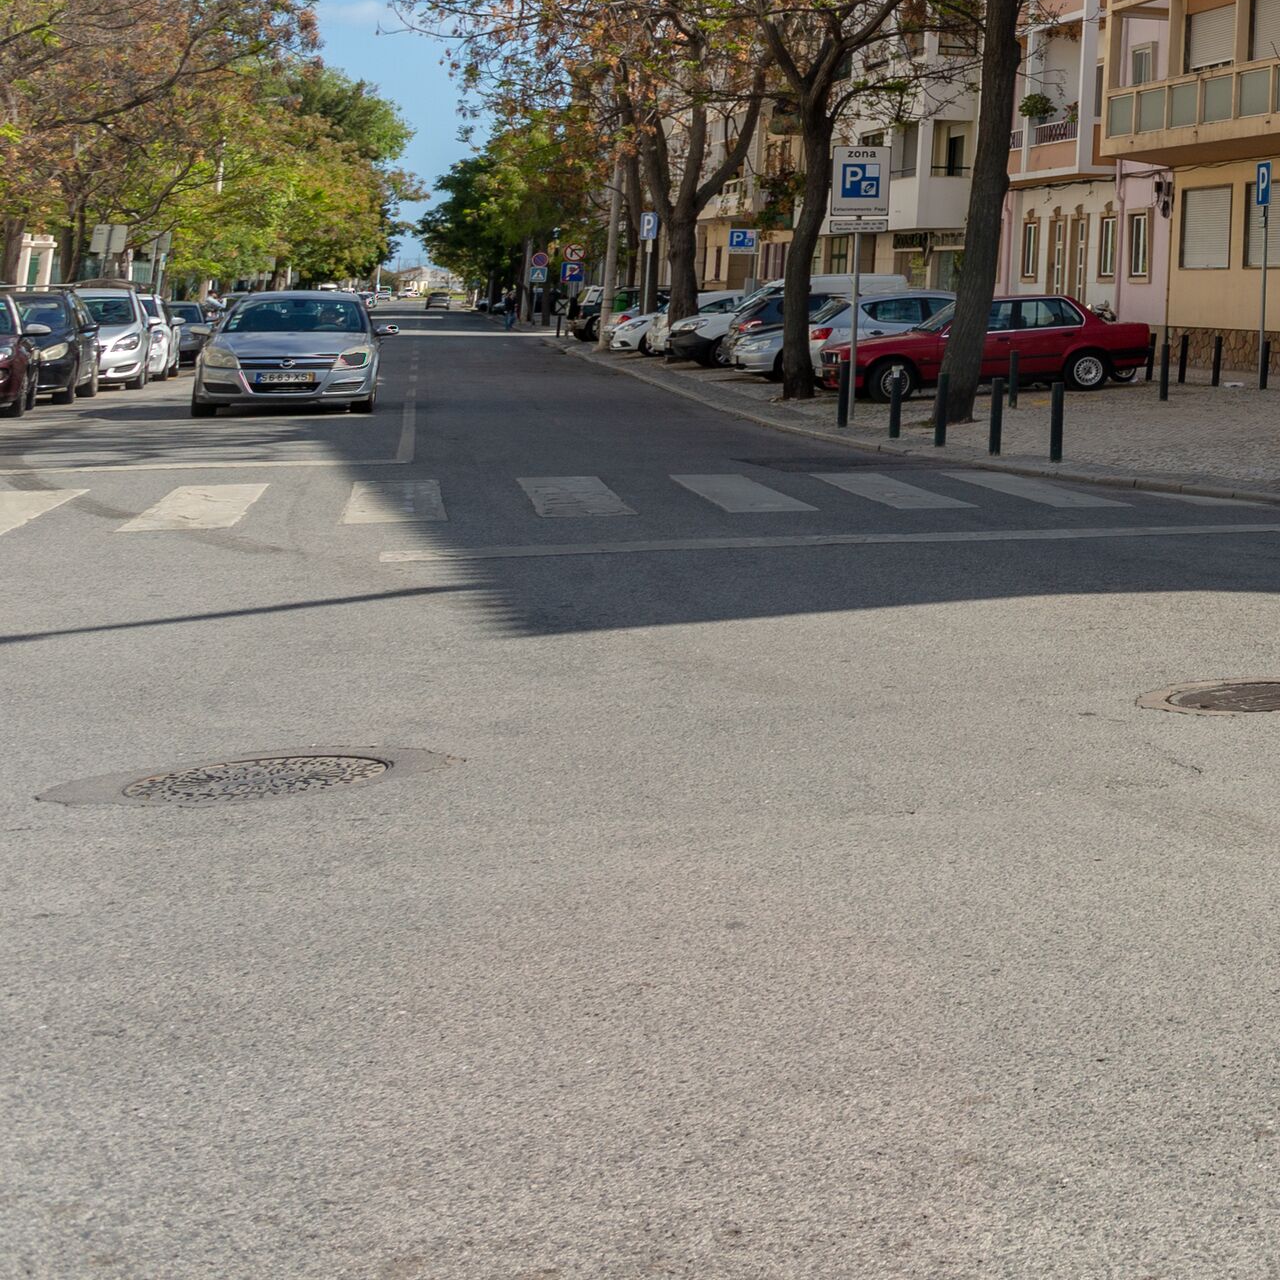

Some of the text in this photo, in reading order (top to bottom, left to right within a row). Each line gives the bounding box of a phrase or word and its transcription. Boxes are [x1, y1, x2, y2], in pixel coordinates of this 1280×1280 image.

[848, 150, 877, 158] zona
[845, 166, 863, 189] P
[1258, 166, 1268, 202] P
[643, 215, 654, 237] P
[732, 232, 744, 246] P
